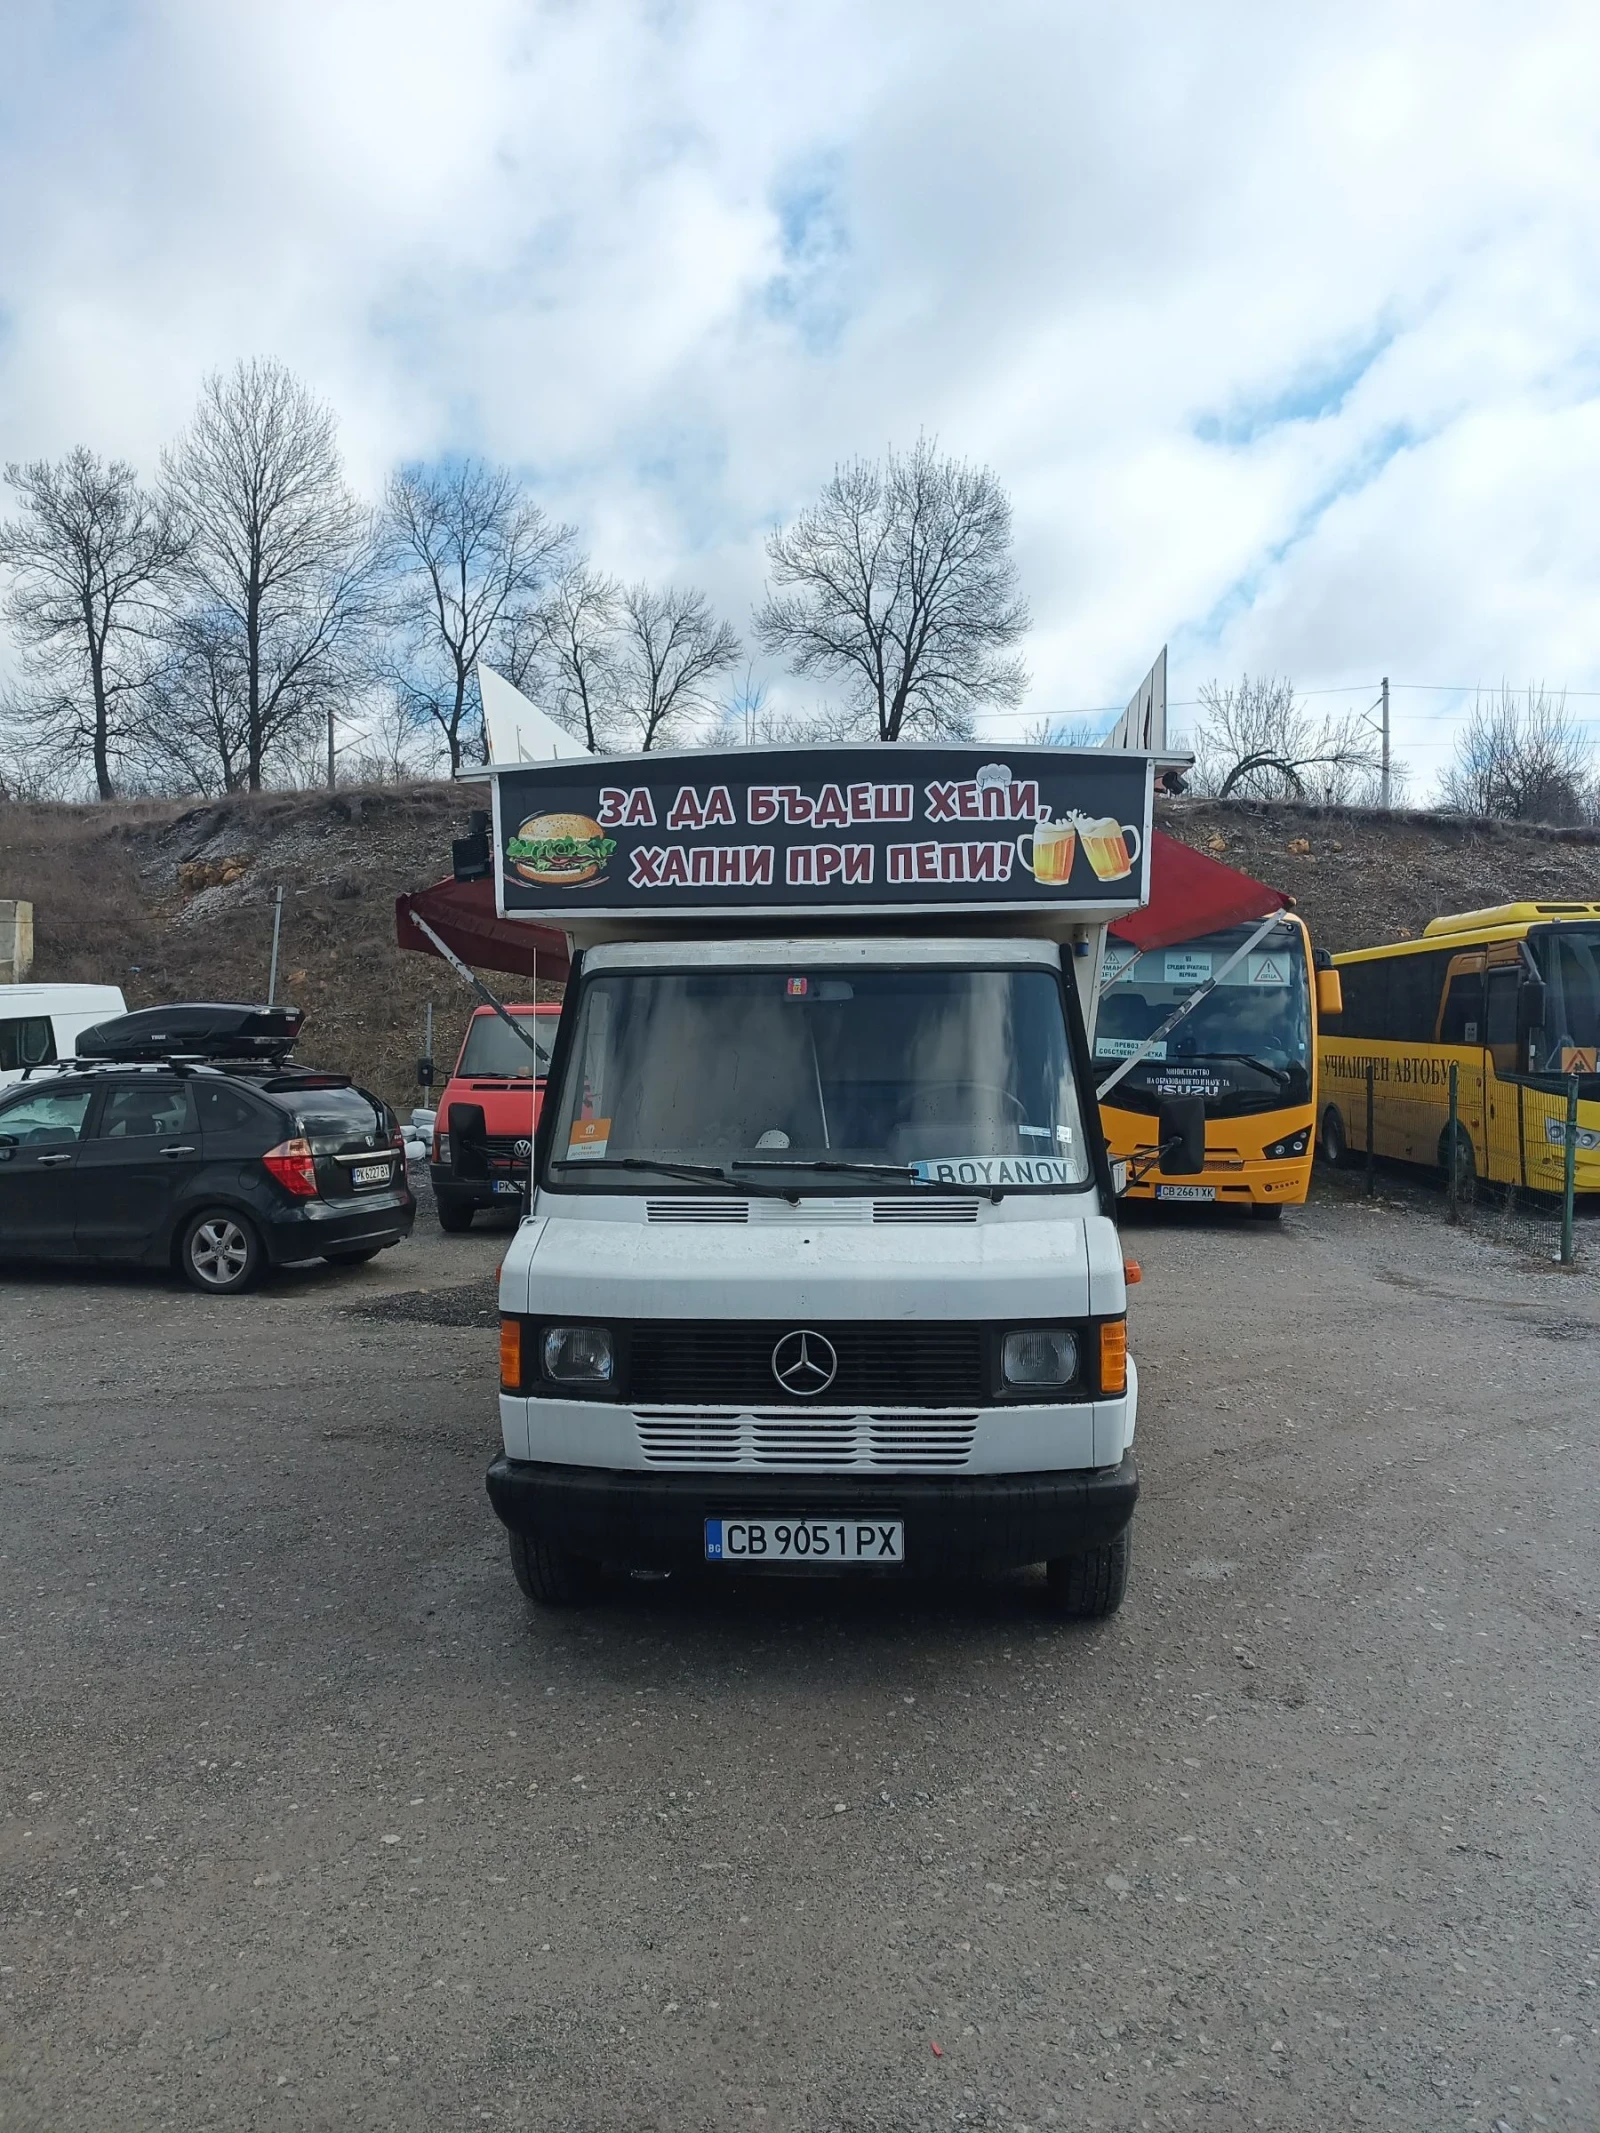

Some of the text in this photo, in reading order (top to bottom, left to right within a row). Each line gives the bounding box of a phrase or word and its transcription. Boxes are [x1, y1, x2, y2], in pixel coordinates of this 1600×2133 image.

[598, 780, 1052, 830] ЗА ДА БЪДЕШ ХЕПИ,
[628, 841, 1015, 888] ХАПНИ ПРИ ПЕПИ!
[1114, 1041, 1139, 1049] ПРЕВОЗ
[1158, 1085, 1219, 1096] ISUZU
[937, 1161, 1068, 1184] BOYANOV
[1162, 1186, 1214, 1197] CB 2661 XK
[708, 1525, 897, 1556] BG CB 9051 PX
